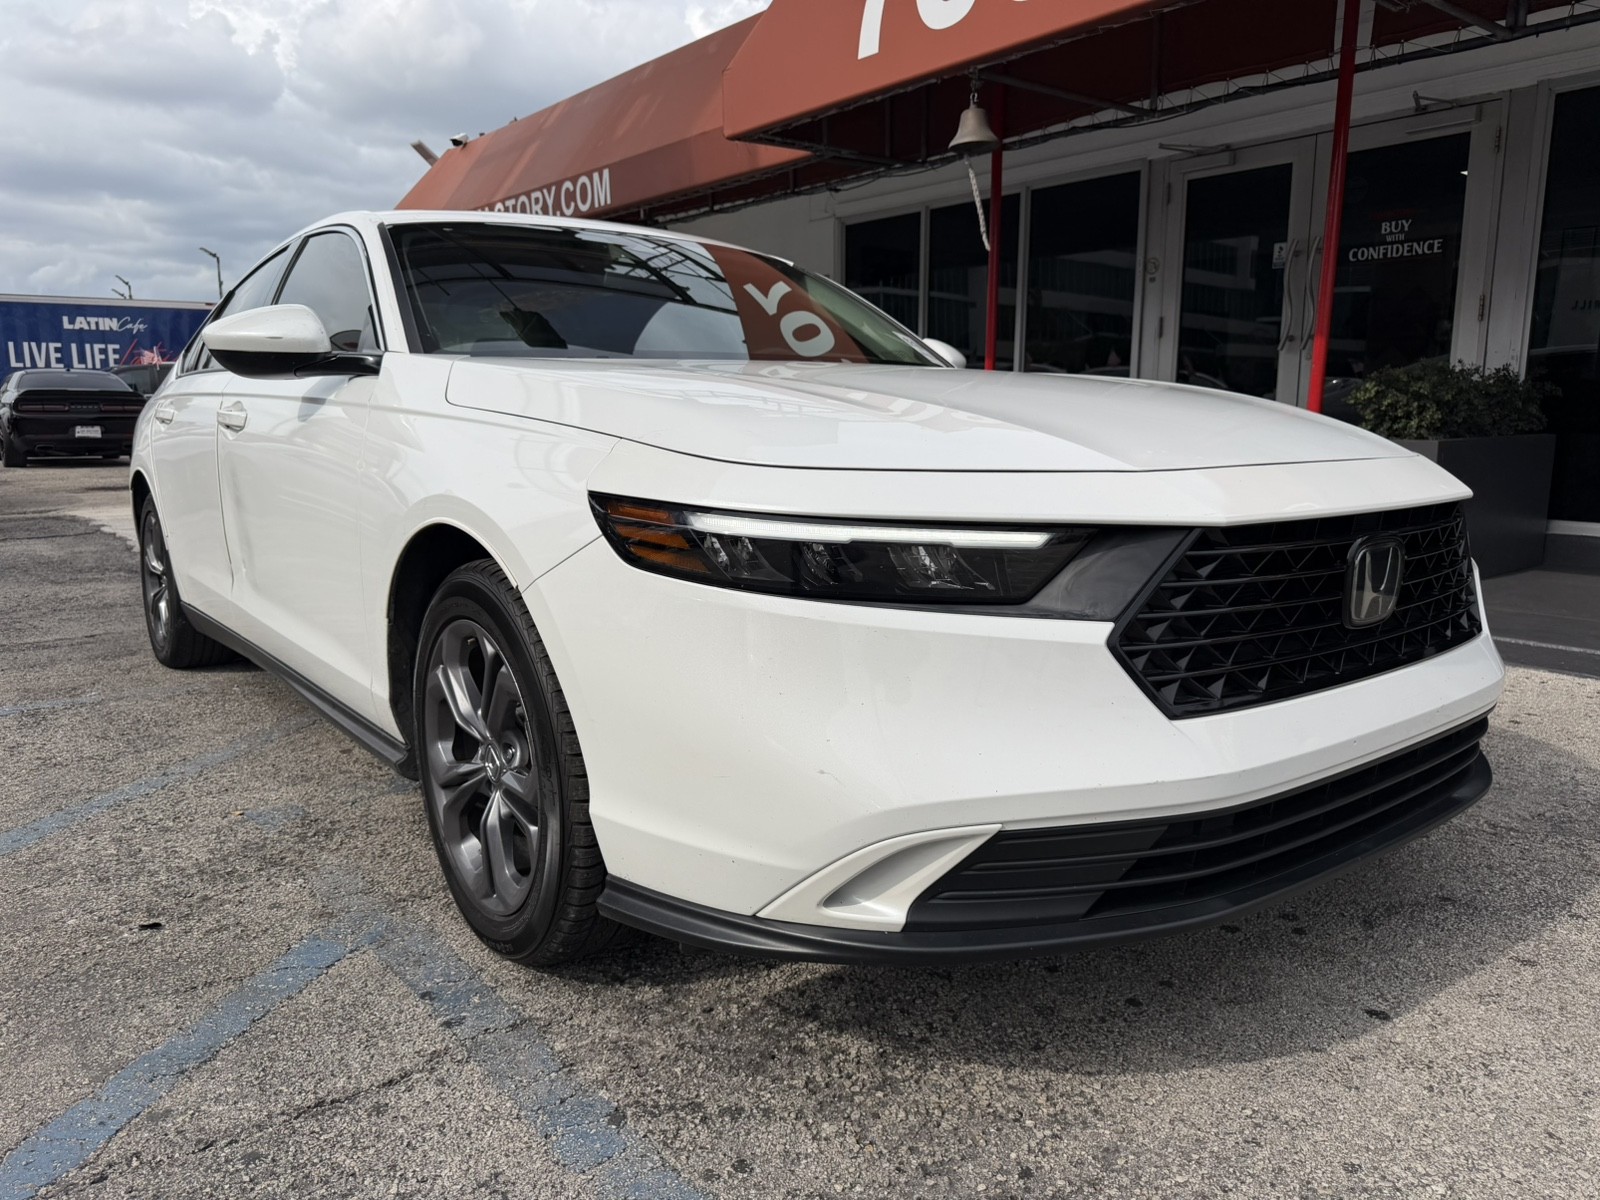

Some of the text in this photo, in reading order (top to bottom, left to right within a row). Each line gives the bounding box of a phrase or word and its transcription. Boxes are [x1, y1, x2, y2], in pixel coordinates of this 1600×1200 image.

[477, 167, 612, 217] TORY.COM
[1381, 219, 1412, 235] BUY
[1386, 233, 1405, 243] WITH
[1348, 238, 1444, 263] CONFIDENCE
[62, 315, 118, 331] LATIN
[7, 341, 65, 368] LIVE
[70, 343, 121, 370] LIFE
